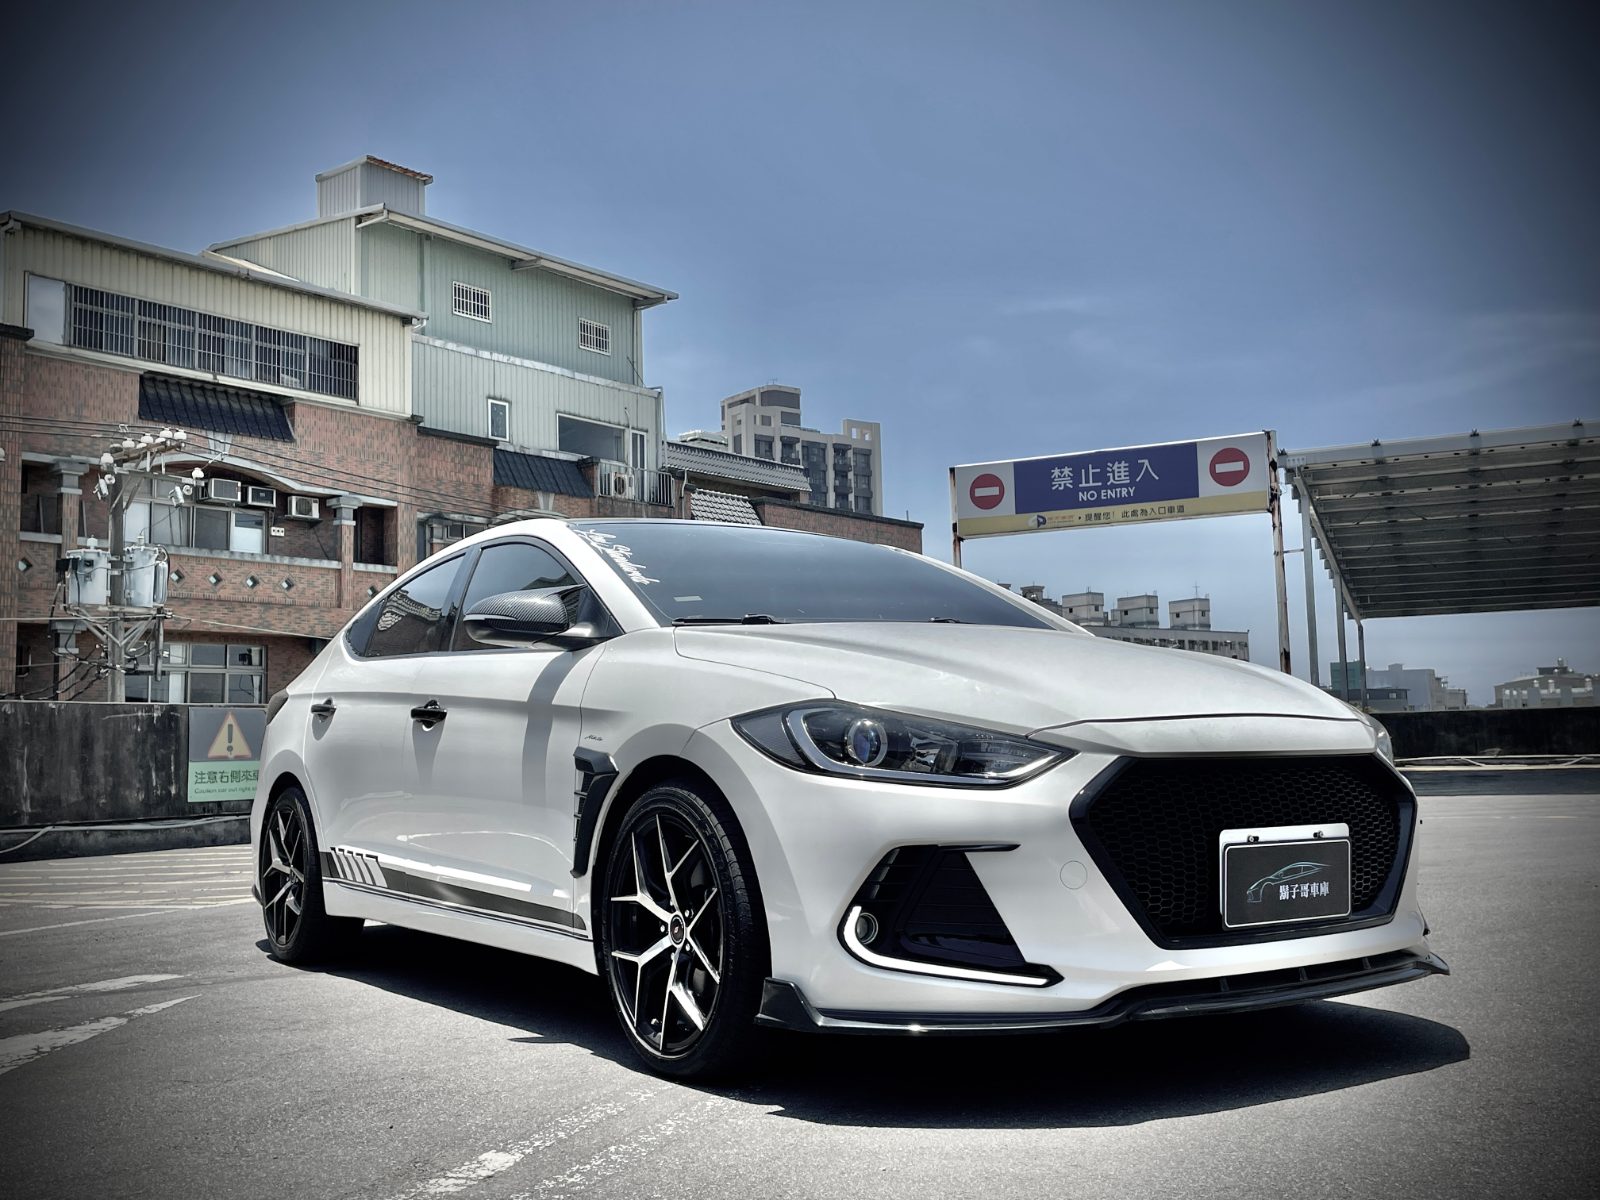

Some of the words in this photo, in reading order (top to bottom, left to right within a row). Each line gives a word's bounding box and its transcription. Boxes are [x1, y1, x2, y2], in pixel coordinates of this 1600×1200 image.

[1051, 458, 1159, 490] 禁止進入
[1078, 490, 1098, 502] NO
[1100, 486, 1136, 501] ENTRY
